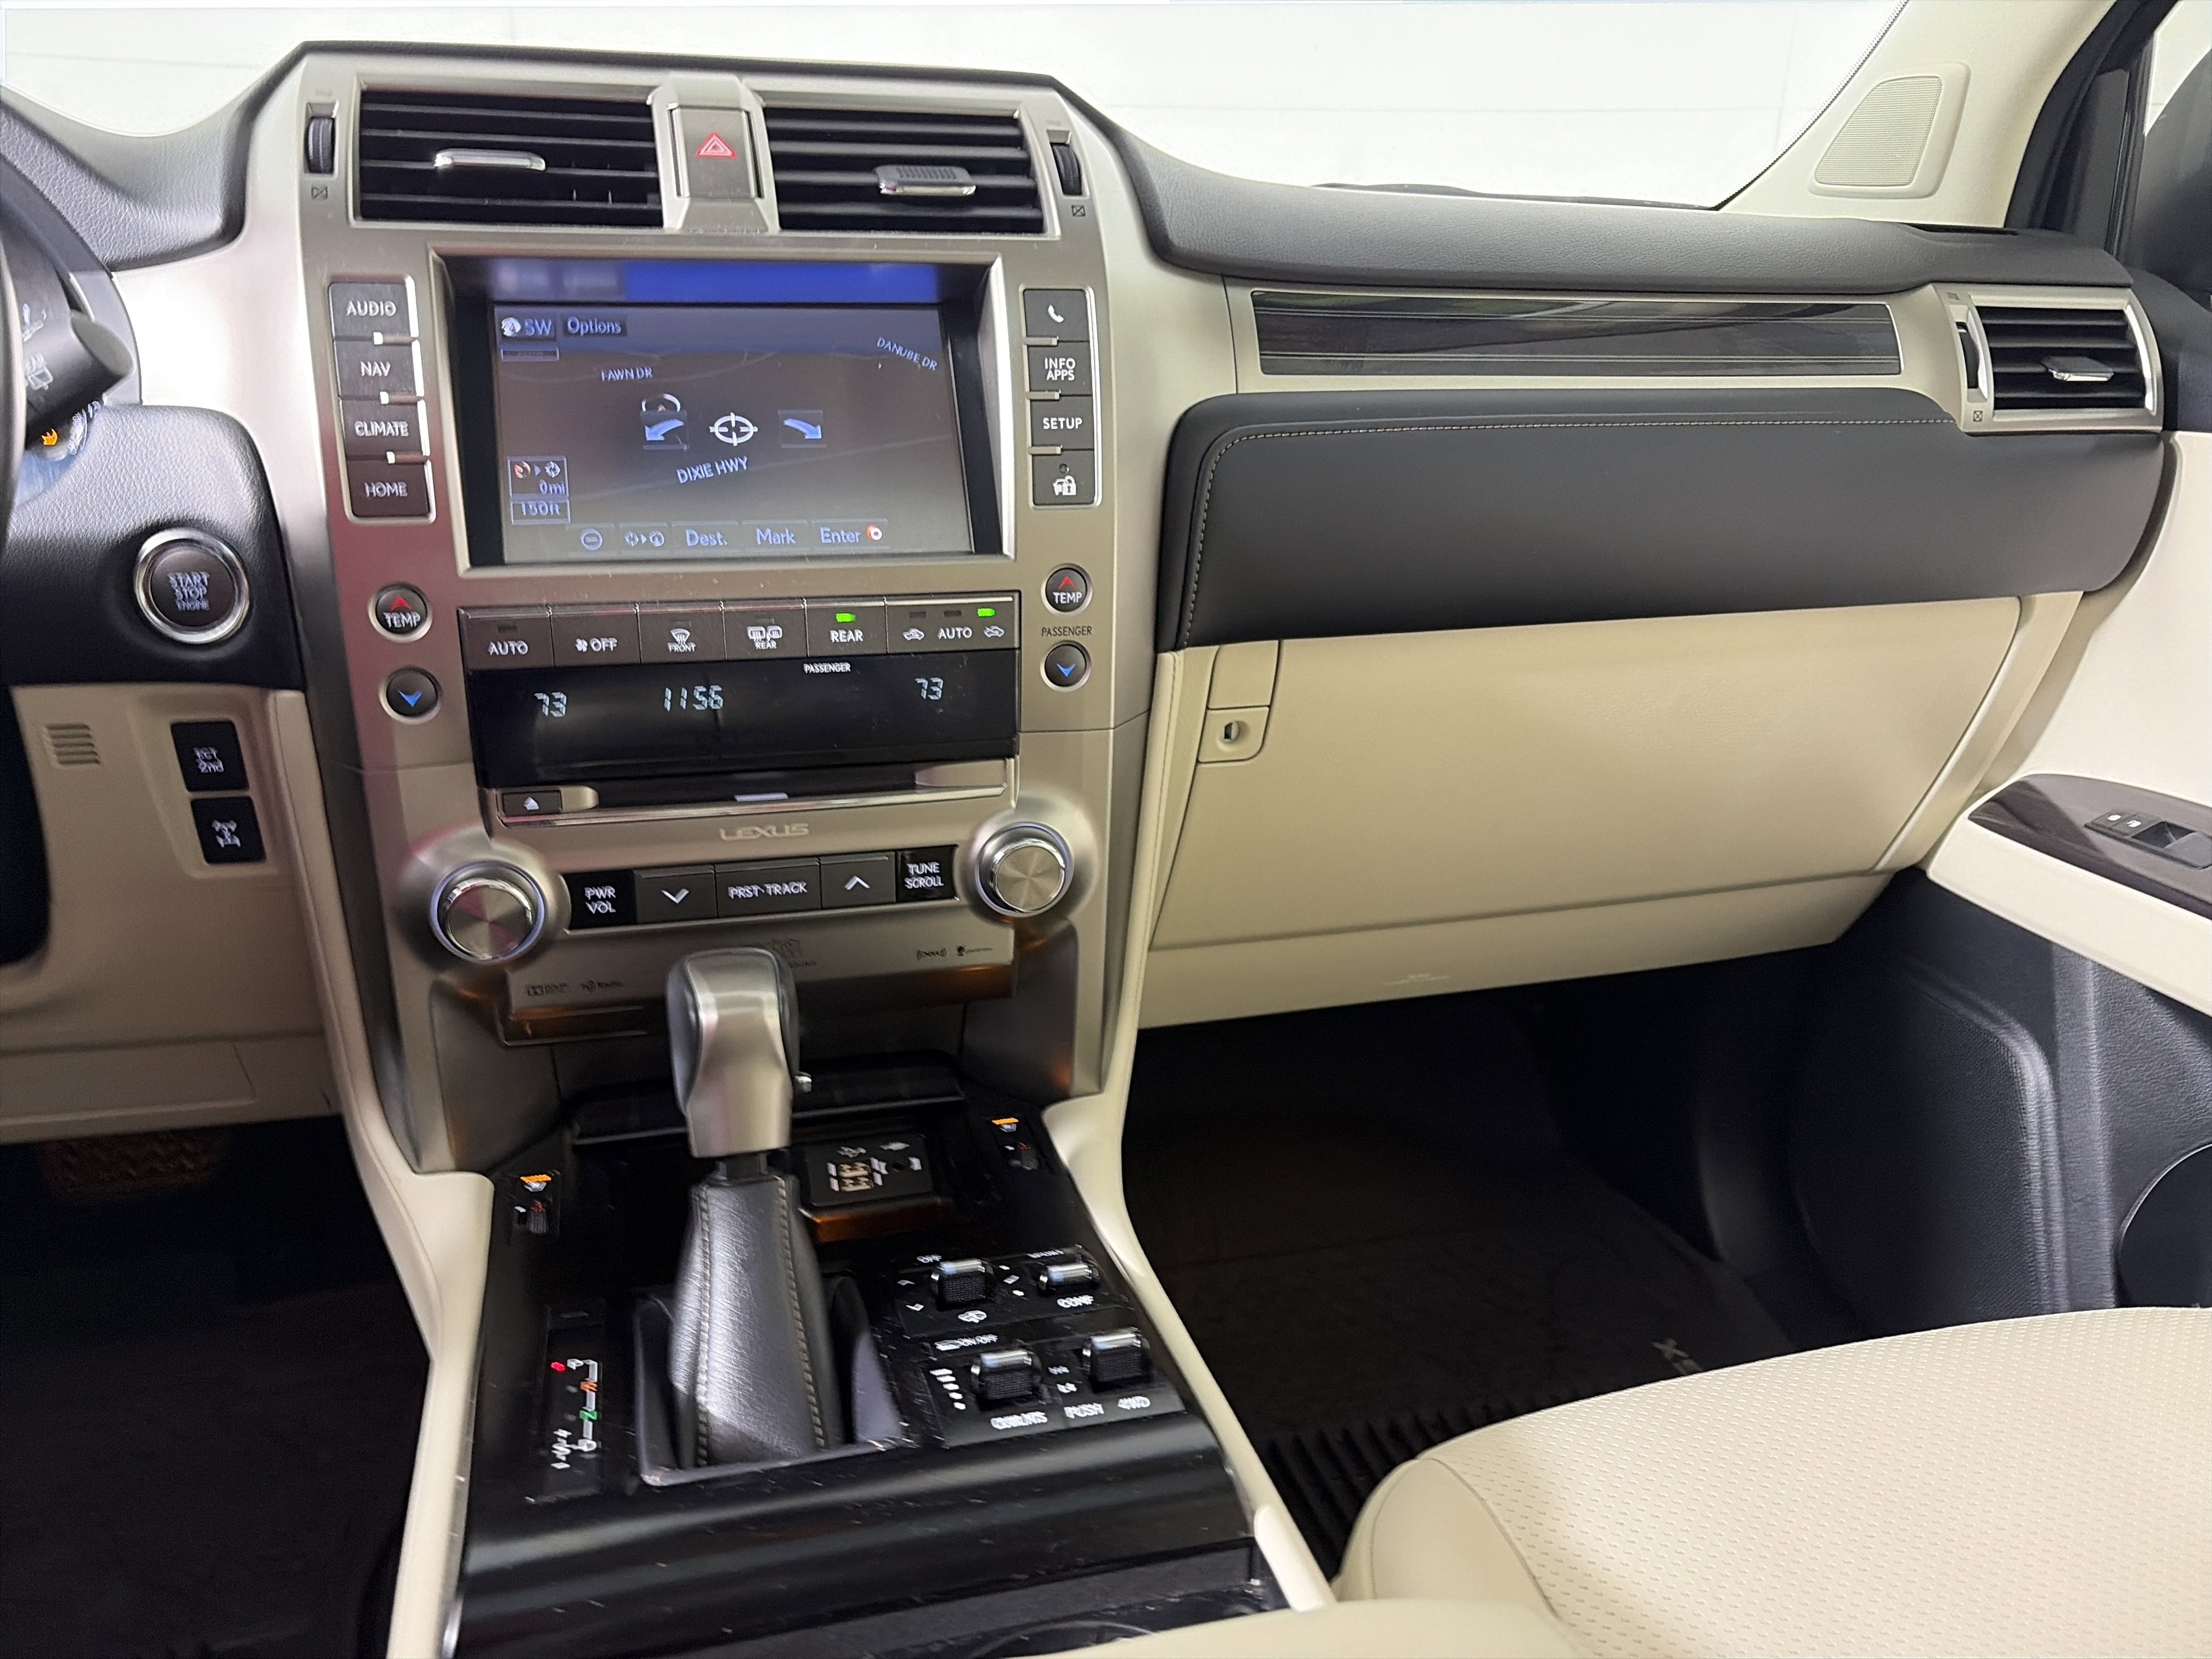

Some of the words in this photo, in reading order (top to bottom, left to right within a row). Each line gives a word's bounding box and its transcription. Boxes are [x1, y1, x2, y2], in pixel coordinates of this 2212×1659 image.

[346, 300, 397, 317] AUDIO
[524, 319, 553, 336] SW
[567, 316, 622, 336] Options
[877, 336, 921, 363] DANUBE
[922, 356, 937, 371] DR
[360, 361, 391, 377] NAV
[1045, 358, 1076, 370] INFO
[636, 366, 653, 380] DR
[1046, 369, 1075, 381] APPS
[354, 421, 409, 437] CLIMATE
[1043, 417, 1082, 430] SETUP
[676, 463, 714, 484] DIXIE
[715, 456, 748, 475] HWY
[364, 482, 408, 498] HOME
[685, 528, 727, 548] Dest.
[756, 528, 795, 545] Mark
[820, 527, 861, 545] Enter
[1053, 591, 1082, 605] TEMP
[383, 612, 421, 629] TEMP
[830, 629, 864, 643] REAR
[938, 627, 972, 640] AUTO
[1041, 625, 1092, 637] PASSENGER
[488, 640, 528, 656] AUTO
[589, 637, 618, 652] OFF
[667, 642, 696, 653] FRONT
[755, 641, 777, 650] REAR
[803, 662, 851, 674] PASSENGER
[915, 676, 945, 701] 73
[534, 691, 567, 718] 73
[719, 823, 810, 841] LEXUS
[906, 861, 940, 875] TUNE
[904, 876, 944, 889] SCROLL
[584, 886, 616, 900] PWR
[585, 900, 617, 915] VOL
